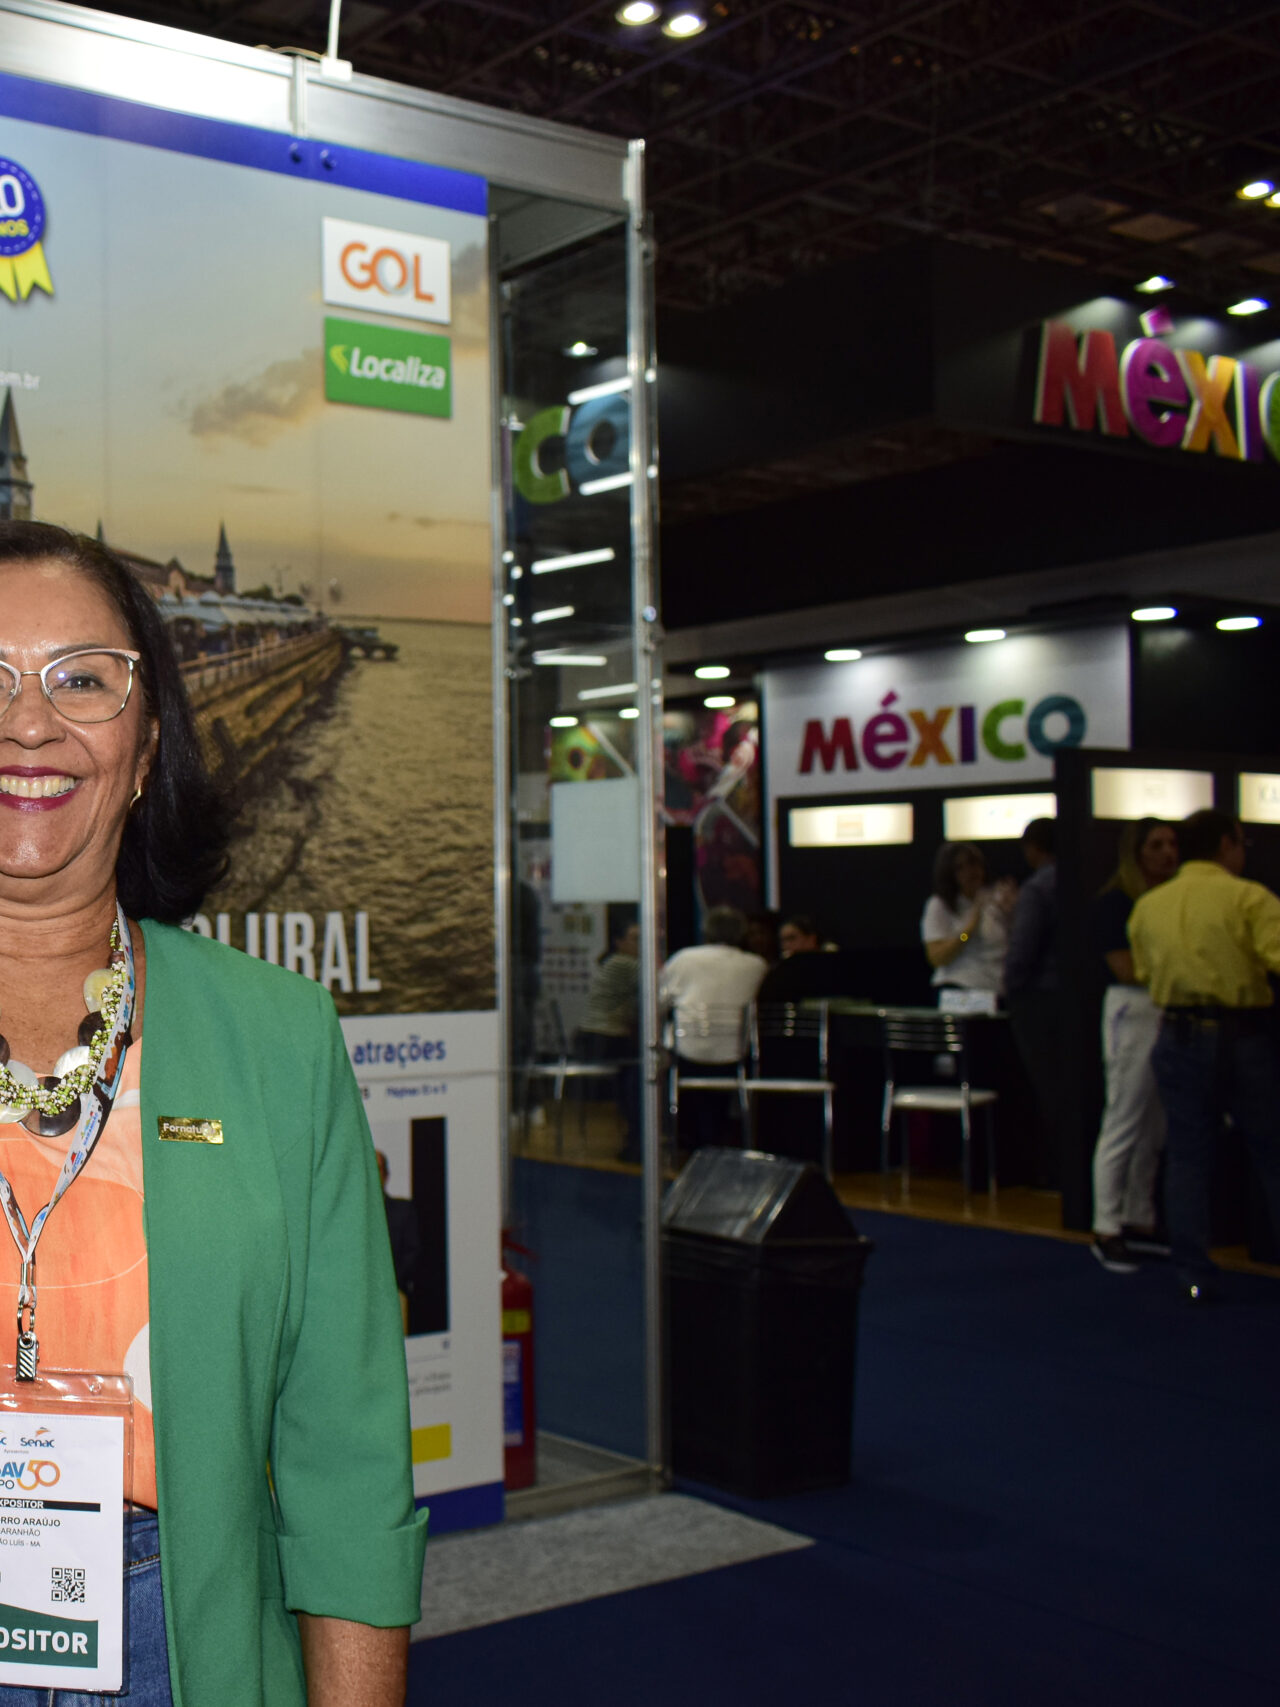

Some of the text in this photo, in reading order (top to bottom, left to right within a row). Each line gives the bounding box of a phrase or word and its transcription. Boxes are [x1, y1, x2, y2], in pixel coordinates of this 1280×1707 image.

[340, 240, 435, 302] GOL
[349, 346, 446, 389] Localiza
[181, 912, 381, 993] URAL
[353, 1034, 446, 1069] atrações
[20, 1437, 55, 1448] Senac
[16, 1460, 61, 1491] 50
[22, 1516, 61, 1527] ARAÚJO
